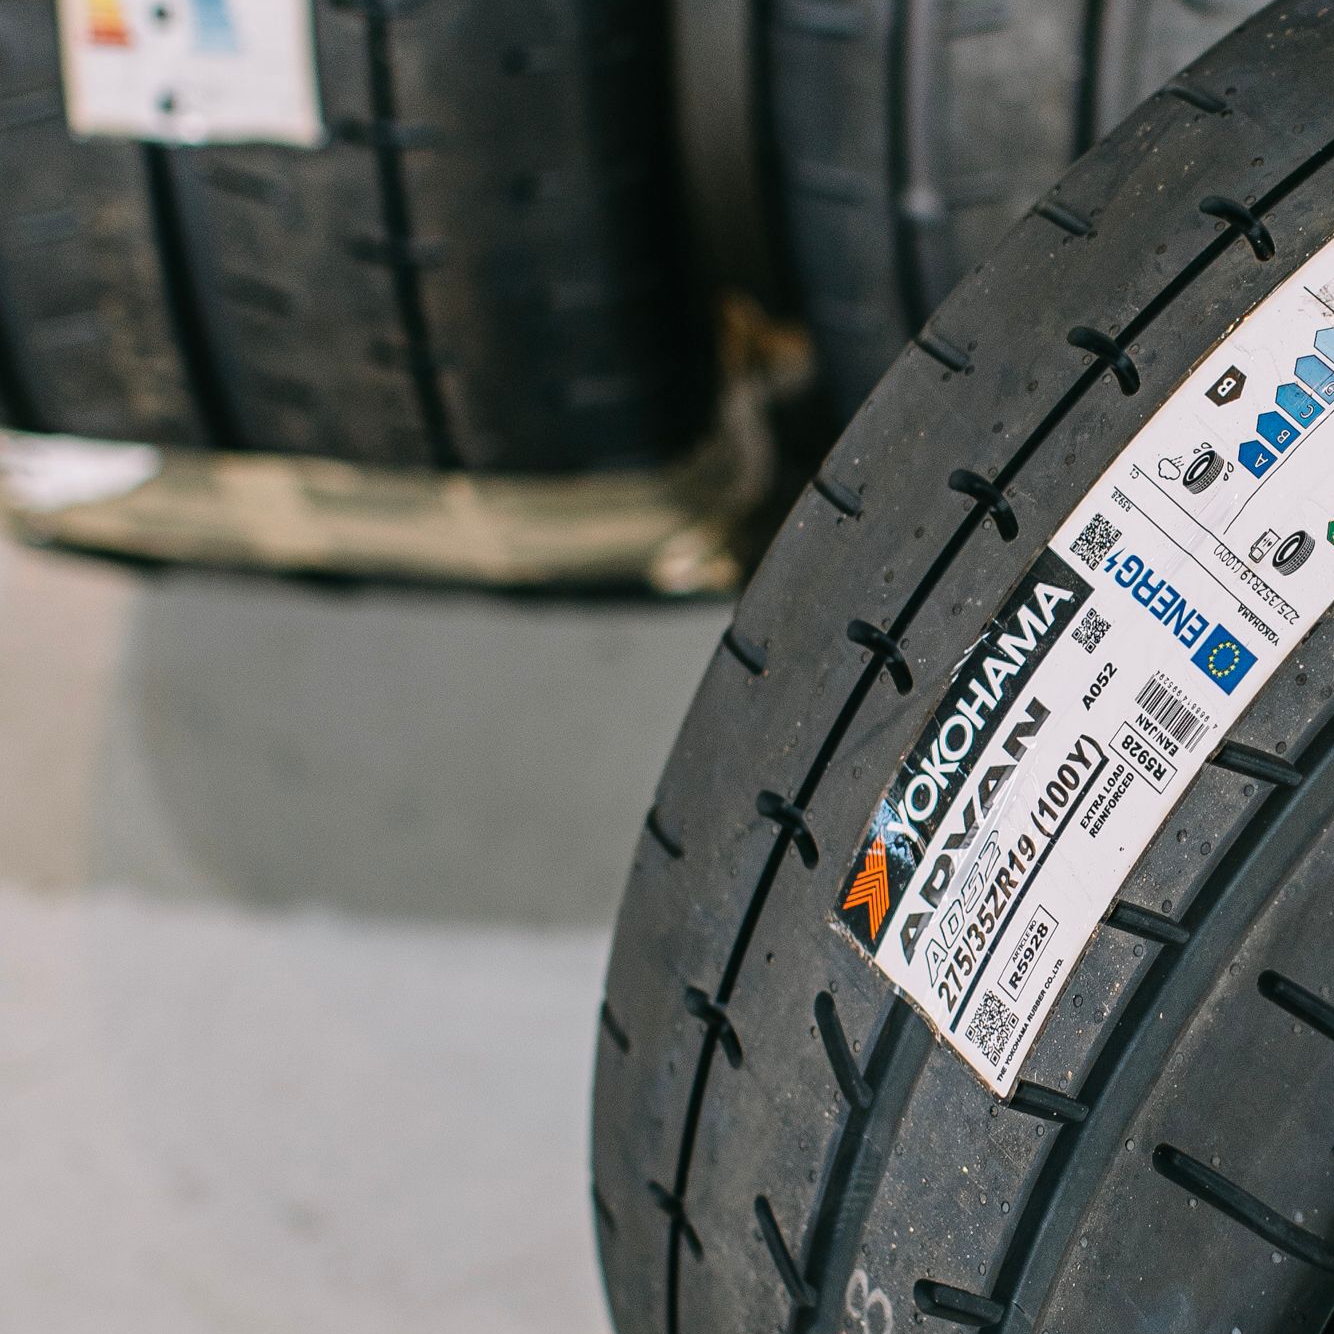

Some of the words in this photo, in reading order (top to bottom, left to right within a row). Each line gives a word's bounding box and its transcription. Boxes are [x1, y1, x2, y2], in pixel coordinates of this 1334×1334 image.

[1110, 489, 1135, 512] R5928
[1237, 603, 1279, 646] YOKOHAMA
[886, 581, 1074, 842] YOKOHAMA
[1082, 662, 1117, 710] A052
[1121, 734, 1167, 781] R5928
[1135, 712, 1178, 756] EAN/JAN
[1079, 793, 1106, 829] EXTRA
[1102, 763, 1124, 793] LOAD
[1088, 772, 1134, 838] REINFORCED
[901, 696, 1052, 966] ADVAN
[938, 833, 1037, 1017] 275/35ZR19
[1030, 733, 1105, 840] (100Y)
[1008, 922, 1048, 989] R5928
[1012, 931, 1030, 963] ARTICLE
[996, 1065, 1008, 1083] THE
[1004, 1022, 1029, 1065] YOKOHAMA
[1026, 989, 1046, 1022] RUBBER
